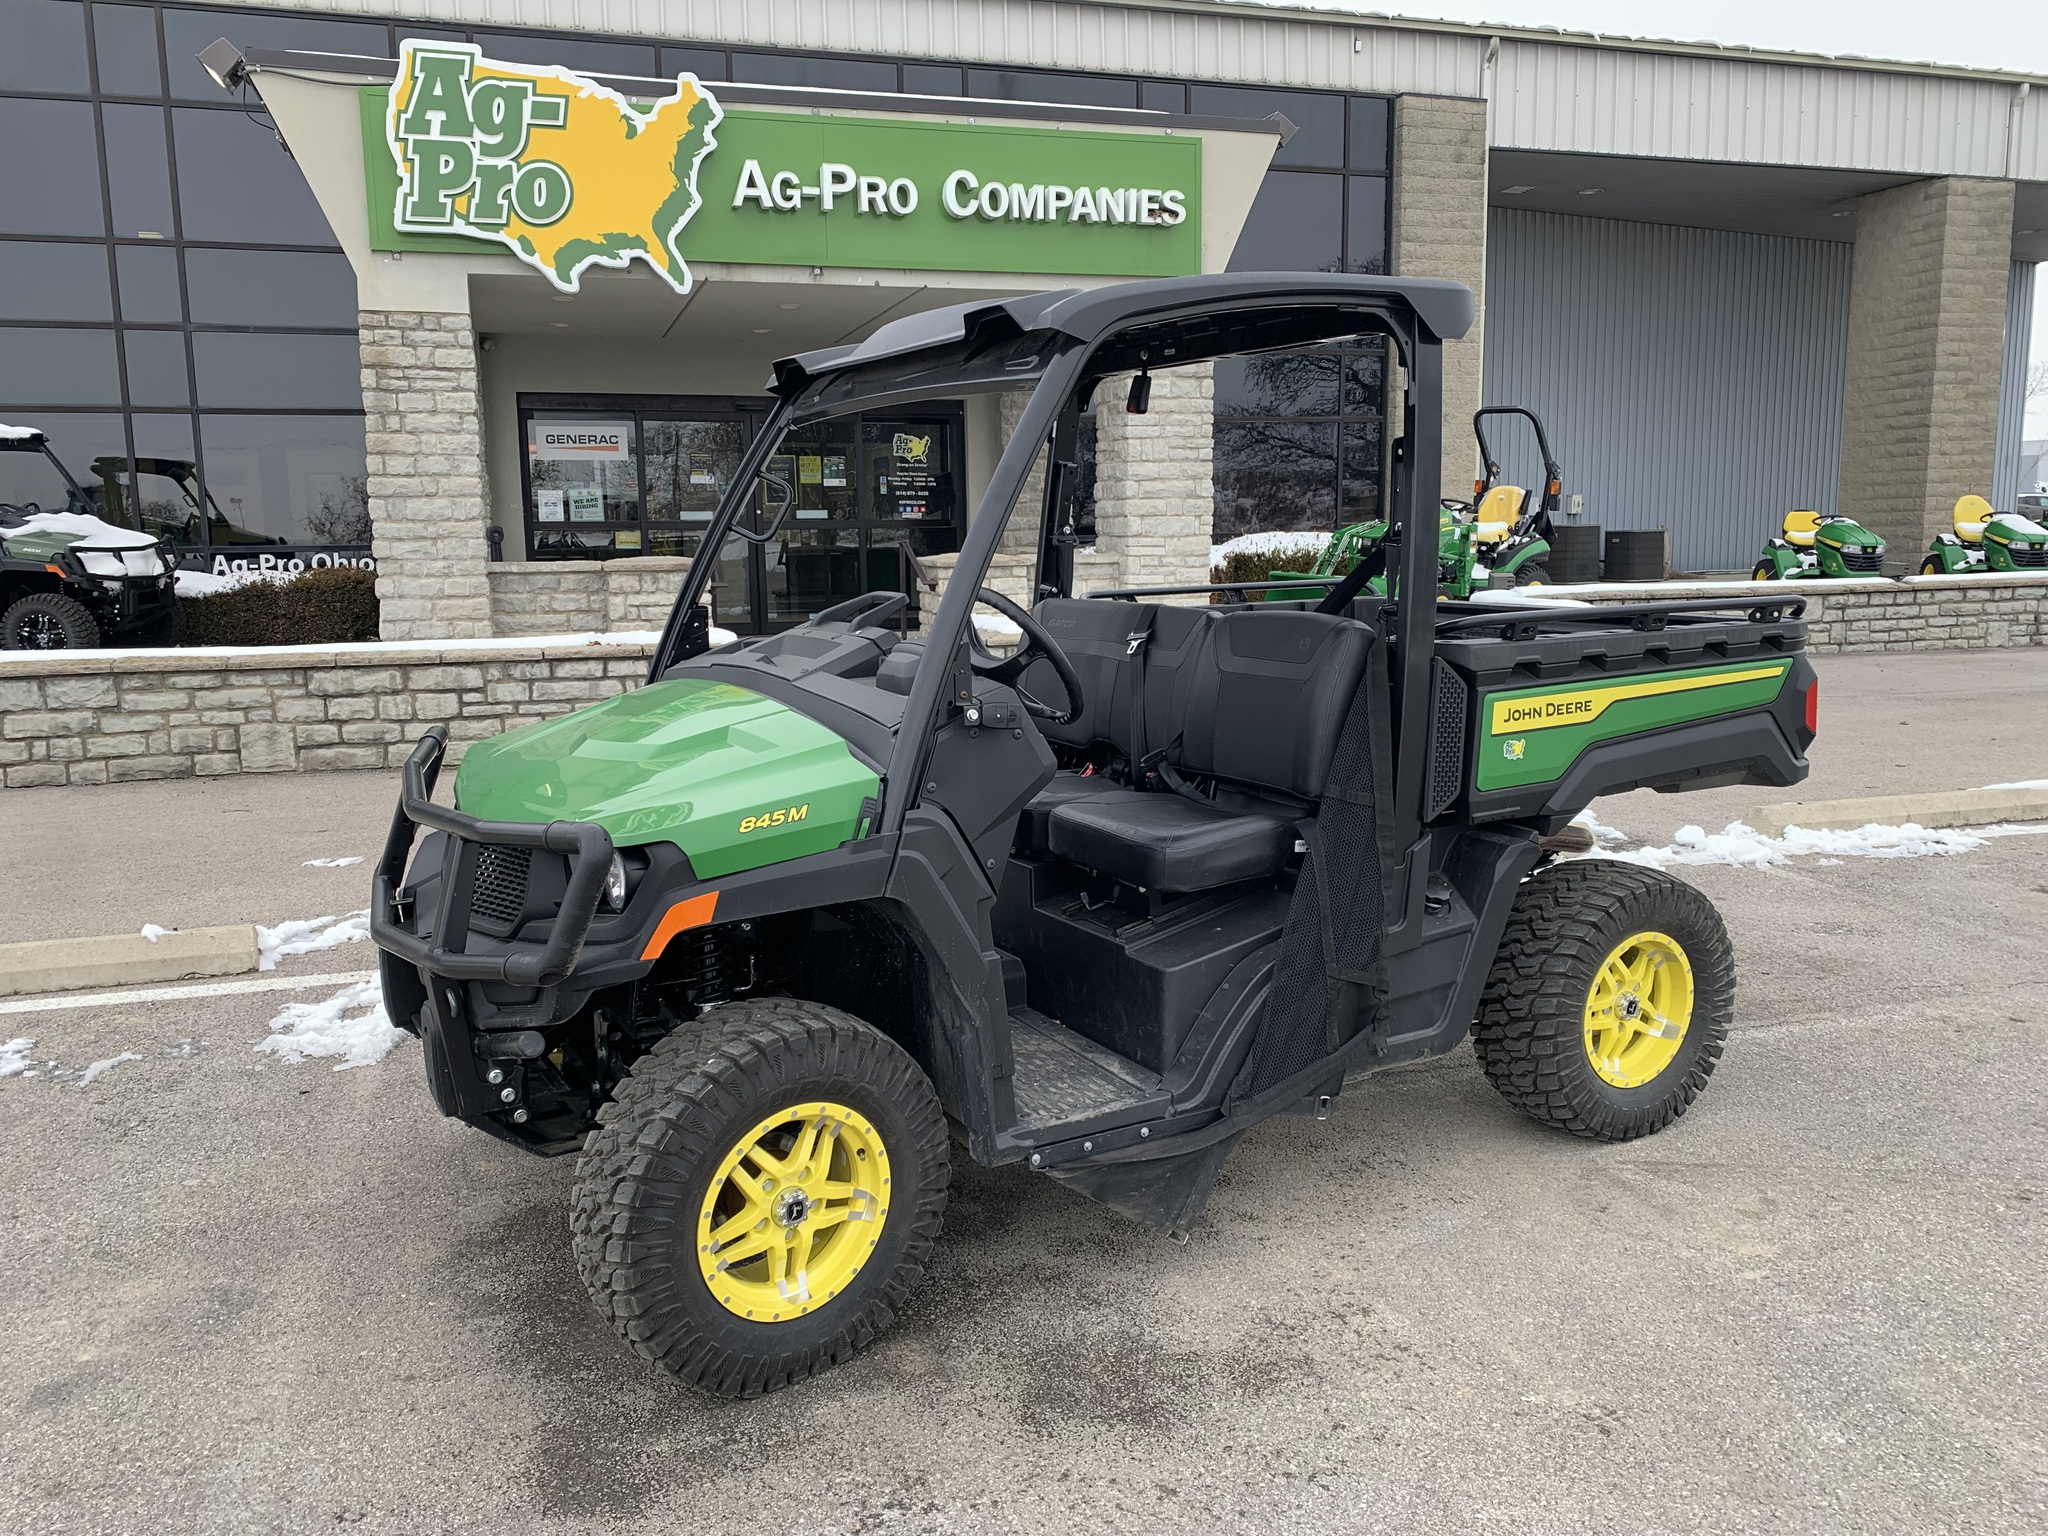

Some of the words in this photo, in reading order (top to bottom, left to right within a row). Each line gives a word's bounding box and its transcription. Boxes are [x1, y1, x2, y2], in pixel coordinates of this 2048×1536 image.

[398, 51, 567, 158] Ag-
[405, 139, 572, 224] Pro
[731, 158, 919, 217] AG-PRO
[942, 169, 1187, 226] COMPANIES
[545, 434, 619, 445] GENERAC
[895, 445, 913, 454] Pro
[1503, 706, 1542, 723] JOHN
[1546, 700, 1593, 718] DEERE
